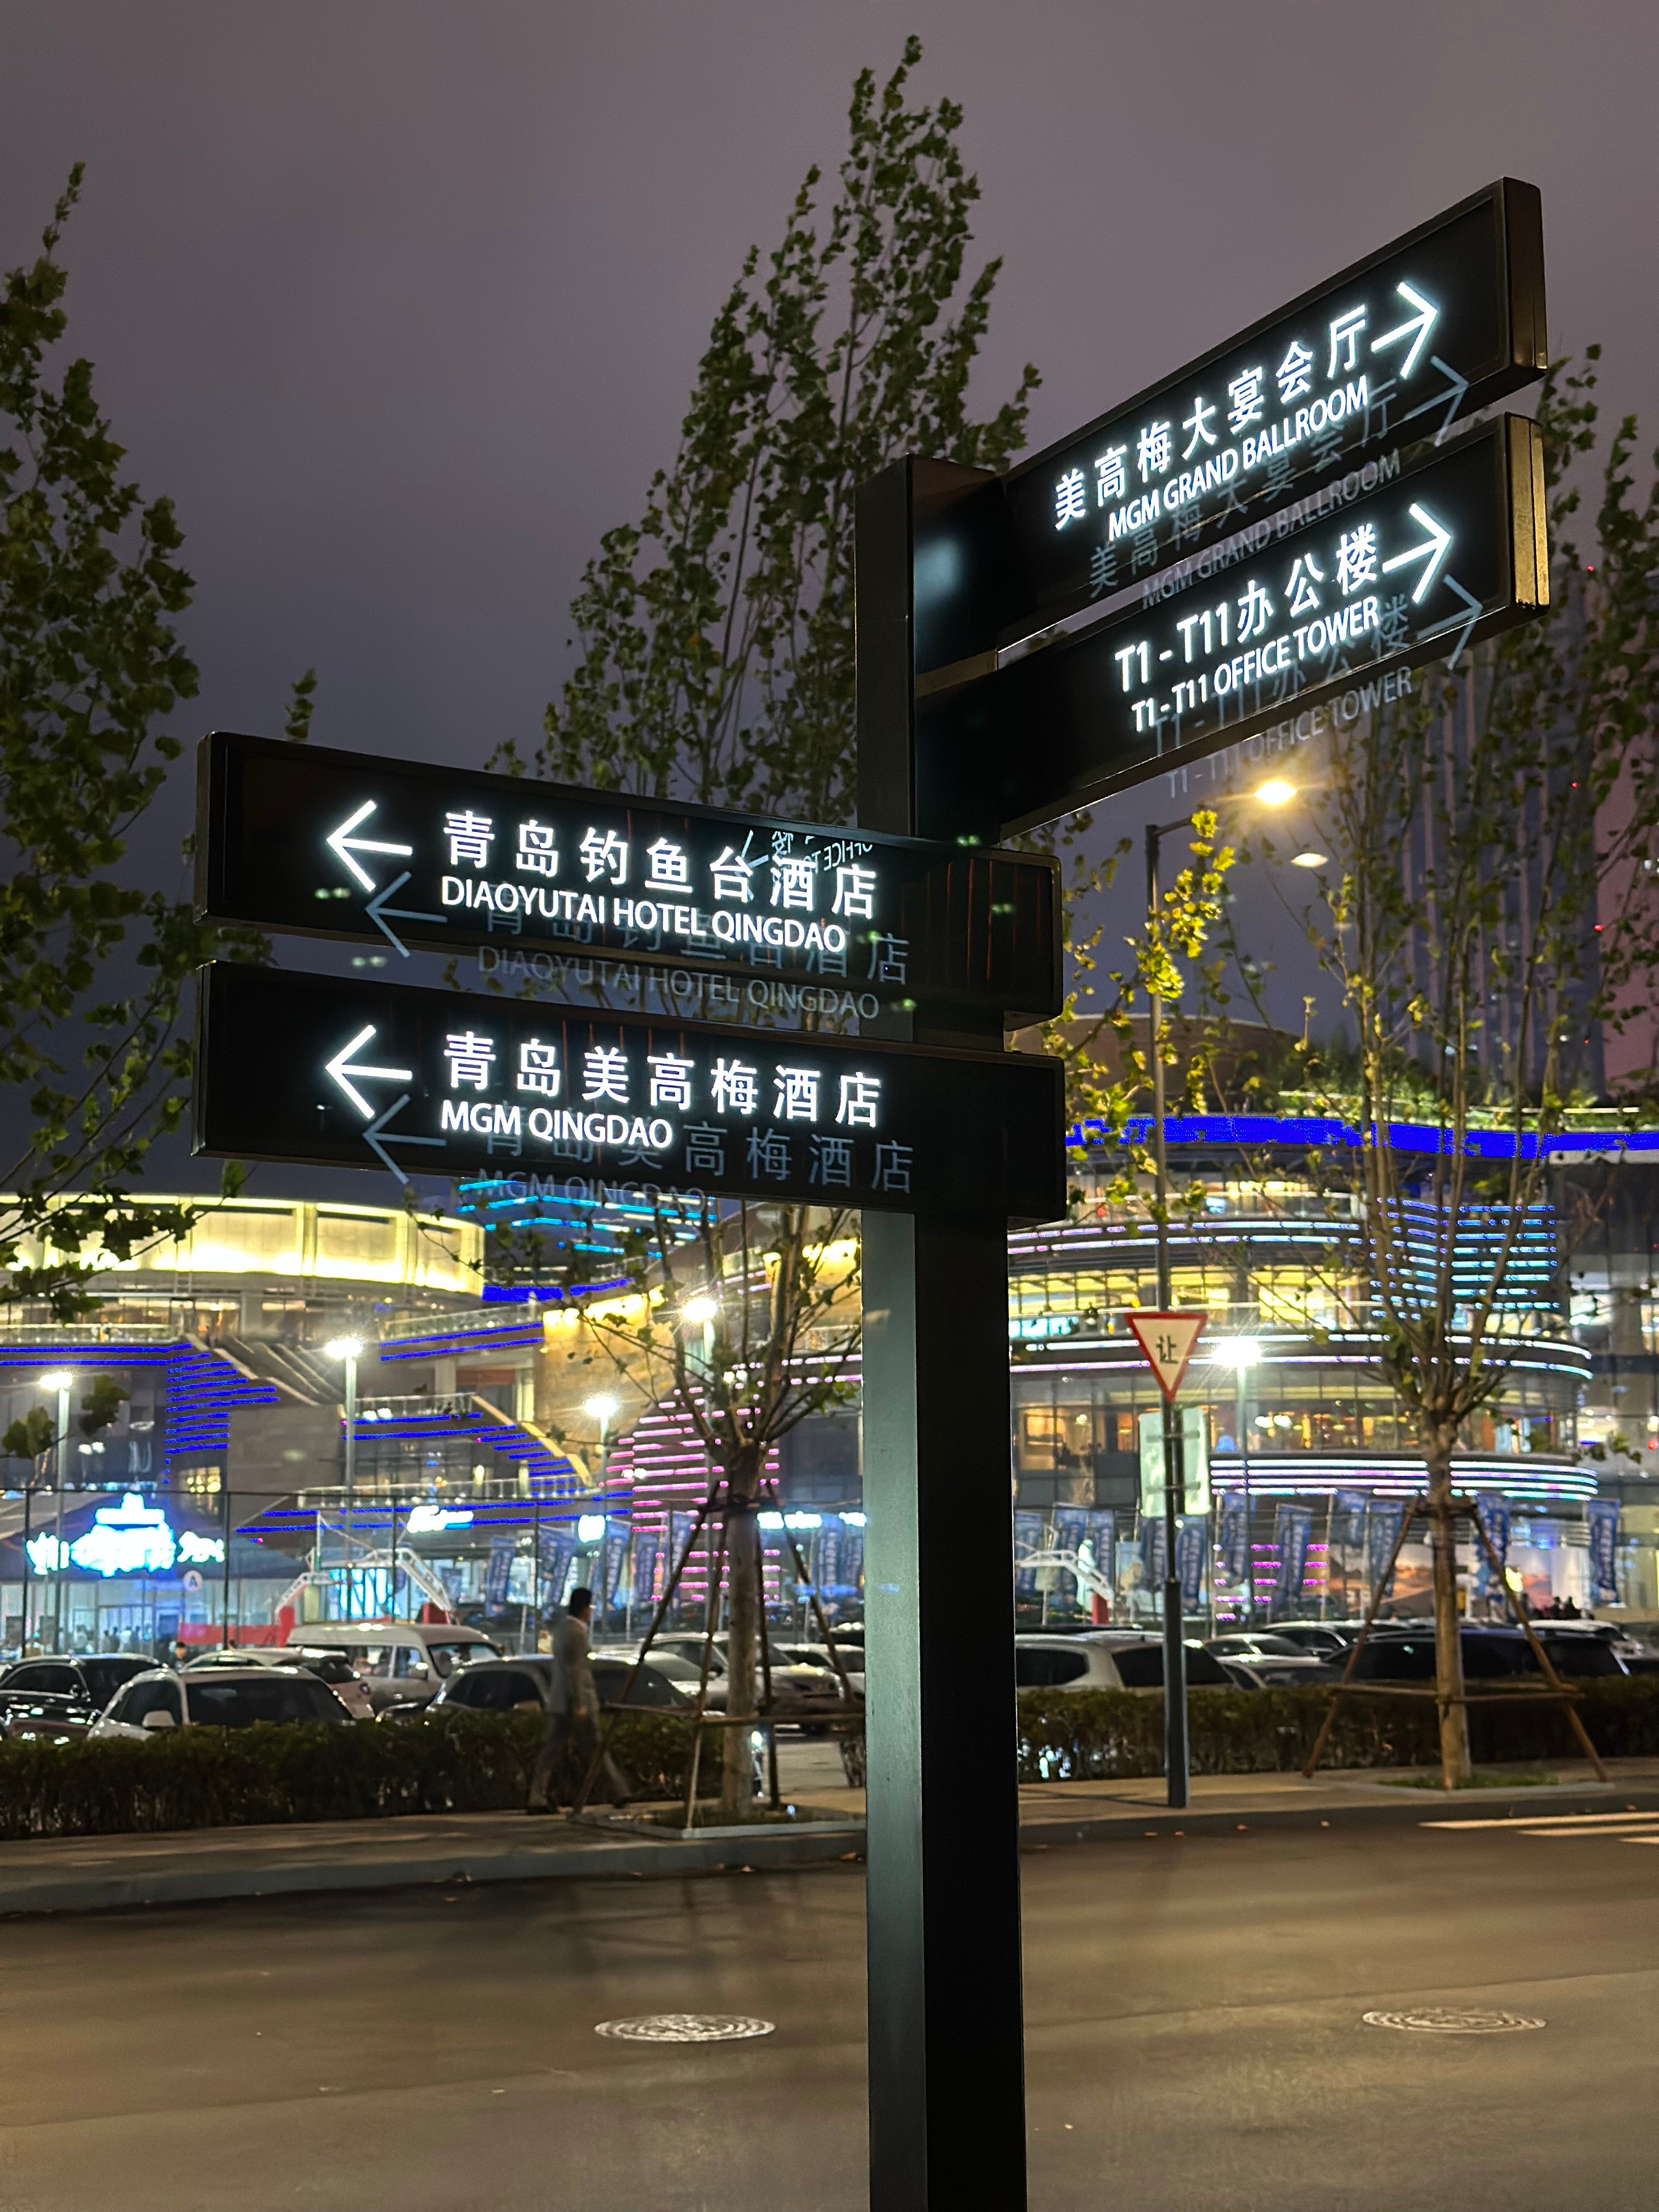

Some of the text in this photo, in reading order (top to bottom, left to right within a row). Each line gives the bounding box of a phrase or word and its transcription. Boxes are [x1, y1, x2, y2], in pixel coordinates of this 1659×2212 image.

[1055, 304, 1366, 531] 美高梅大宴会厅
[1108, 375, 1368, 541] MGM GRAND BALLROOM
[1214, 634, 1291, 696] OFFICE
[1293, 596, 1379, 660] TOWER
[443, 809, 876, 919] 青岛钓鱼台酒店
[442, 876, 606, 924] DIAOYUTAI
[613, 898, 707, 937] HOTEL
[712, 910, 845, 953] QINGDAO
[441, 1099, 673, 1148] MGM QINGDAO
[444, 1031, 881, 1127] 青岛美高梅酒店
[1156, 1335, 1179, 1364] 让
